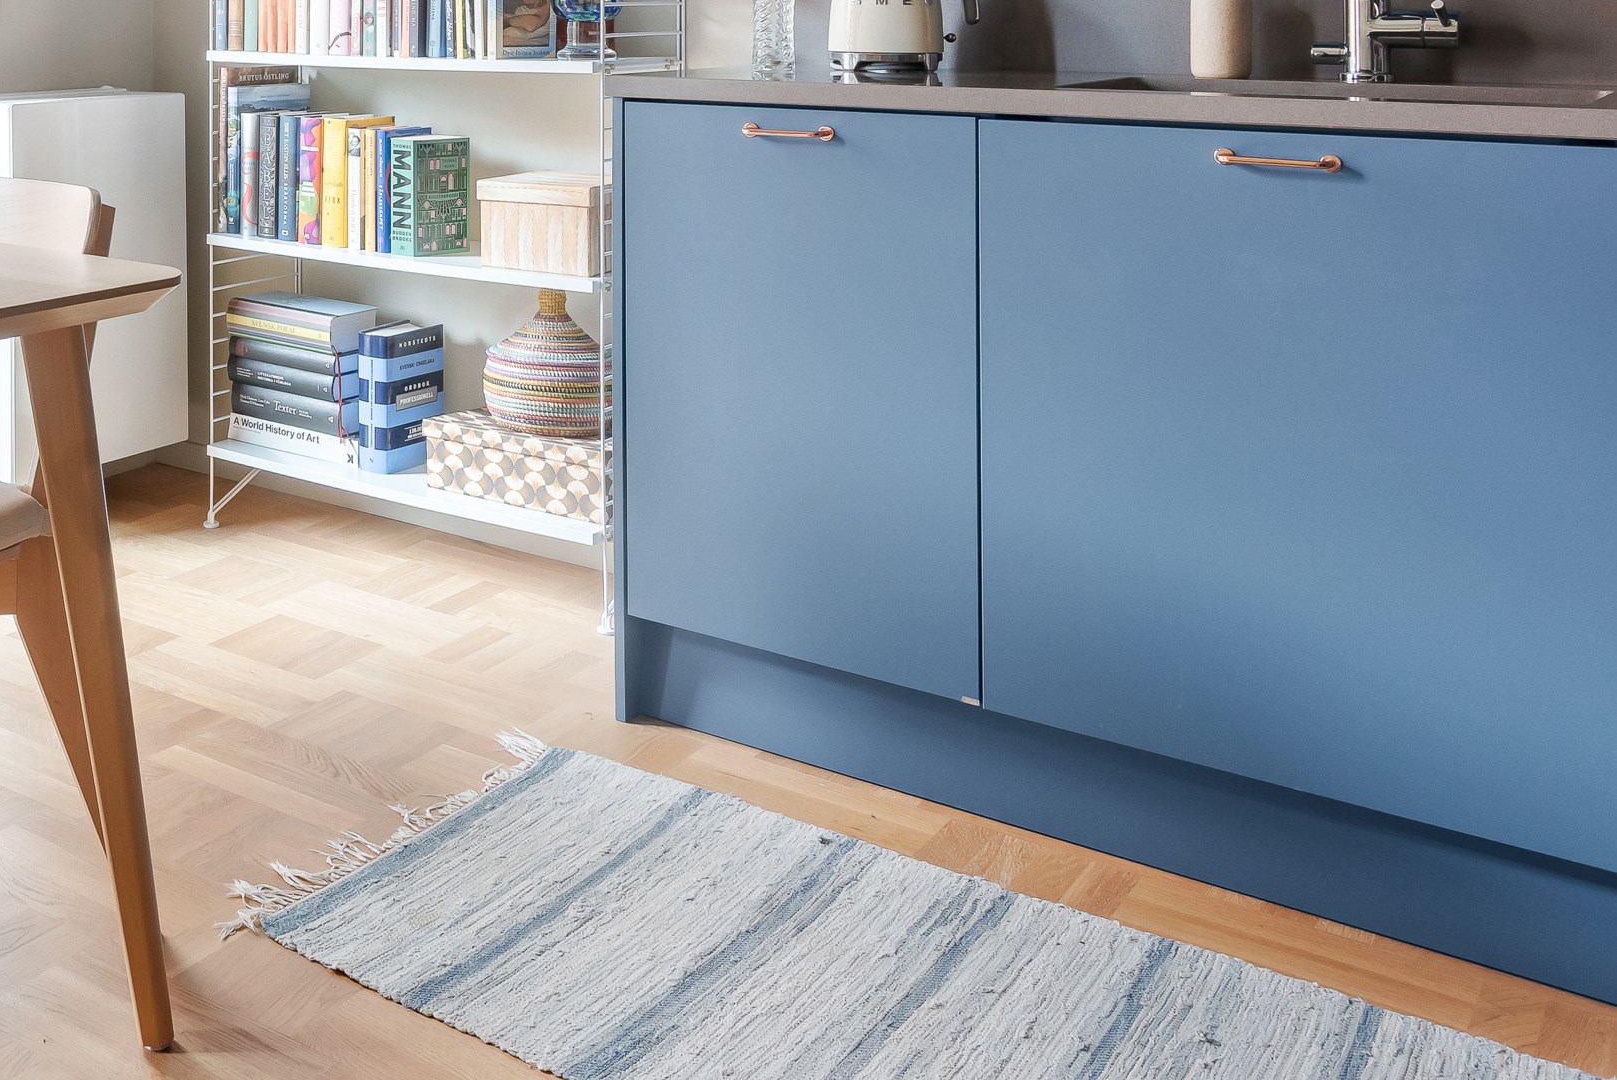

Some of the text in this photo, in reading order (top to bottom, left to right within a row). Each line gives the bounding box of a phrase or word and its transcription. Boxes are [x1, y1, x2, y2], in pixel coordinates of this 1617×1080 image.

[411, 17, 417, 27] MA
[238, 72, 290, 82] BRUTUS ÖSTLING
[263, 133, 272, 222] BABEL
[393, 150, 411, 229] MANN
[251, 319, 276, 331] SVENSK
[398, 336, 436, 348] NORSTEDTS
[404, 380, 430, 392] ORDBOK
[399, 393, 434, 406] PROFESSIONELL
[273, 400, 297, 415] Texter
[233, 416, 240, 425] A
[241, 417, 264, 431] World
[265, 421, 295, 438] History
[296, 430, 305, 440] of
[306, 432, 320, 444] Art
